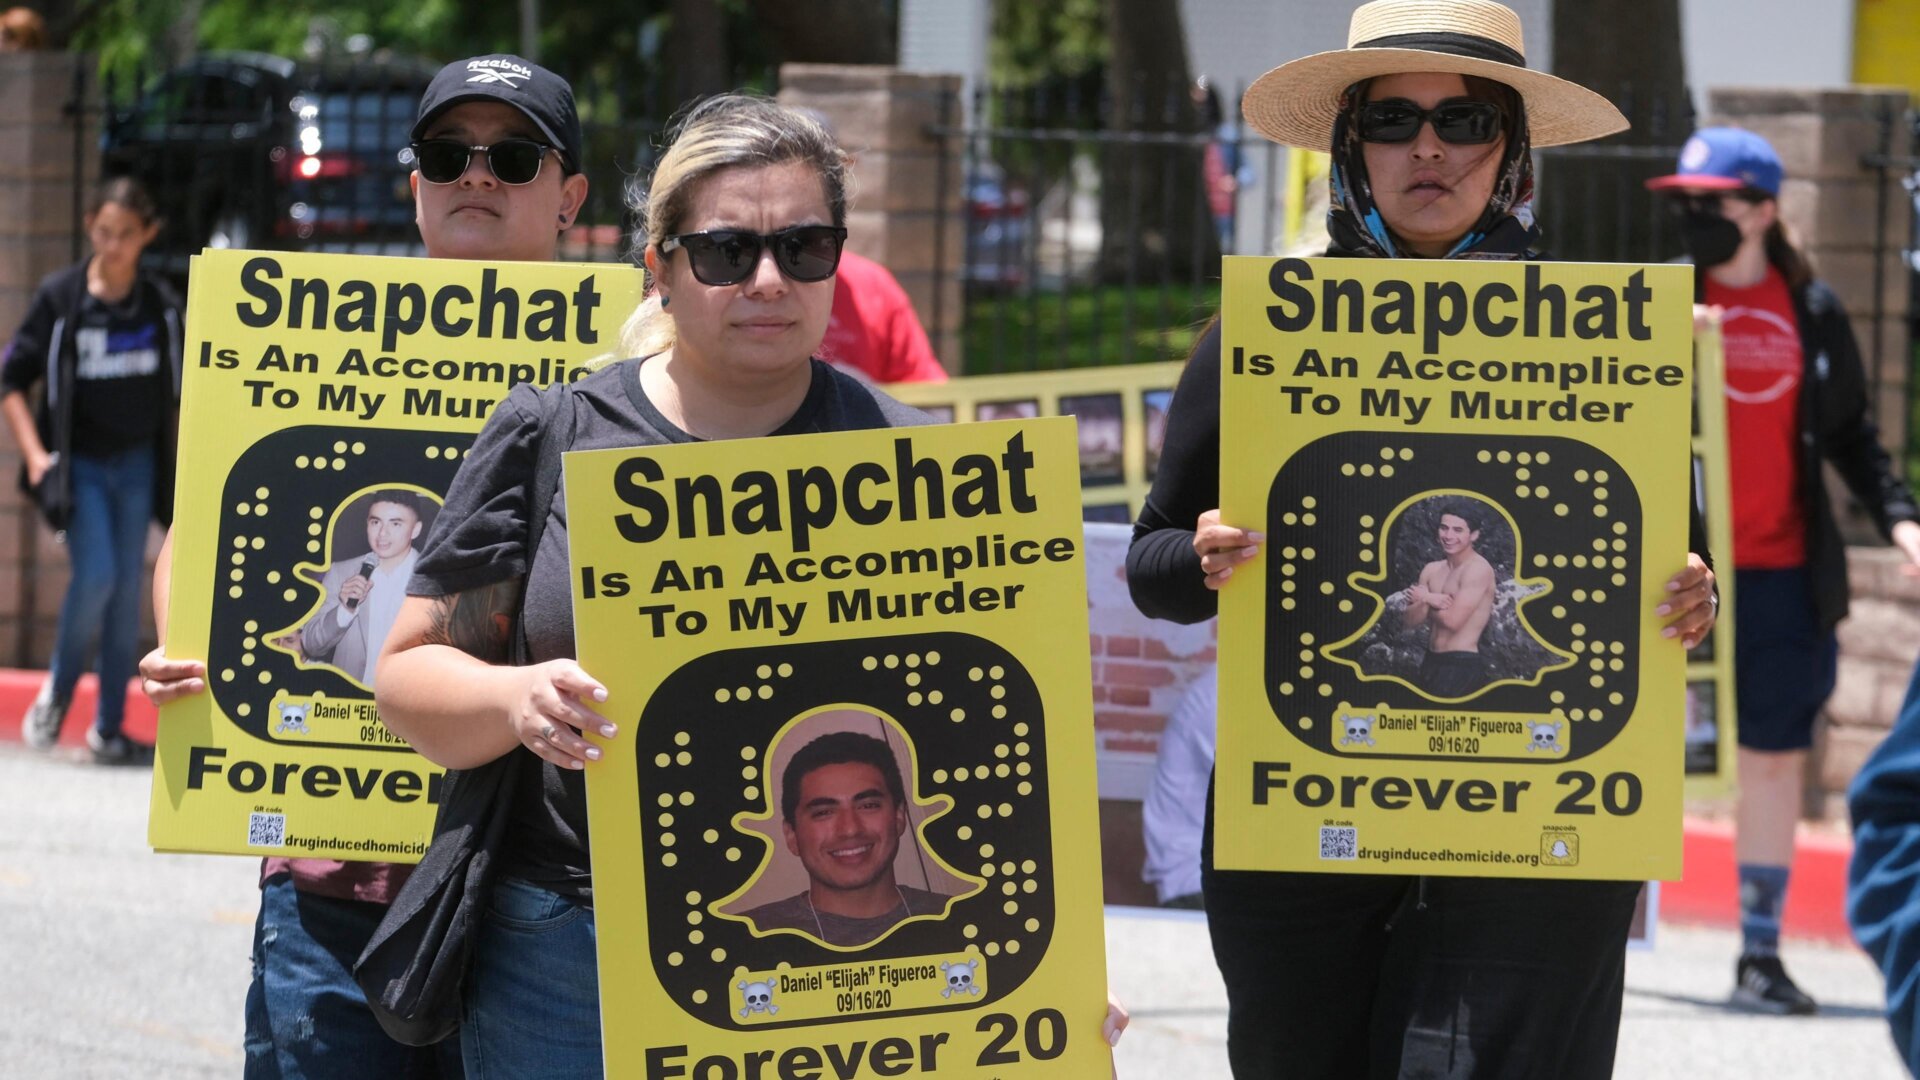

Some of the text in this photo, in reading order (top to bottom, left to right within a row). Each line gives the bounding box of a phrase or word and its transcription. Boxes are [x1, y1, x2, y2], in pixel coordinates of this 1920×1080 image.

[466, 59, 532, 77] Reebok
[236, 257, 601, 352] Snapchat
[1266, 258, 1652, 354] Snapchat
[200, 342, 593, 390] Is An Accomplic
[1233, 347, 1683, 390] Is An Accomplice
[244, 380, 495, 420] To My Mur
[1281, 386, 1633, 425] To My Murder
[614, 431, 1037, 552] Snapchat
[582, 534, 1074, 599] Is An Accomplice
[639, 581, 1024, 637] To My Murder
[314, 703, 381, 725] Daniel “Elij
[1380, 714, 1416, 730] Daniel
[1470, 717, 1522, 736] Figueroa
[1429, 737, 1479, 753] 09/16/20
[1253, 762, 1642, 816] Forever 20
[285, 834, 429, 855] druginducedhomicid
[1358, 847, 1538, 866] druginducedhomicide.org
[781, 972, 822, 993] Daniel
[879, 965, 936, 987] Figueroa
[837, 989, 891, 1012] 09/16/20
[645, 1008, 1067, 1080] Forever 20
